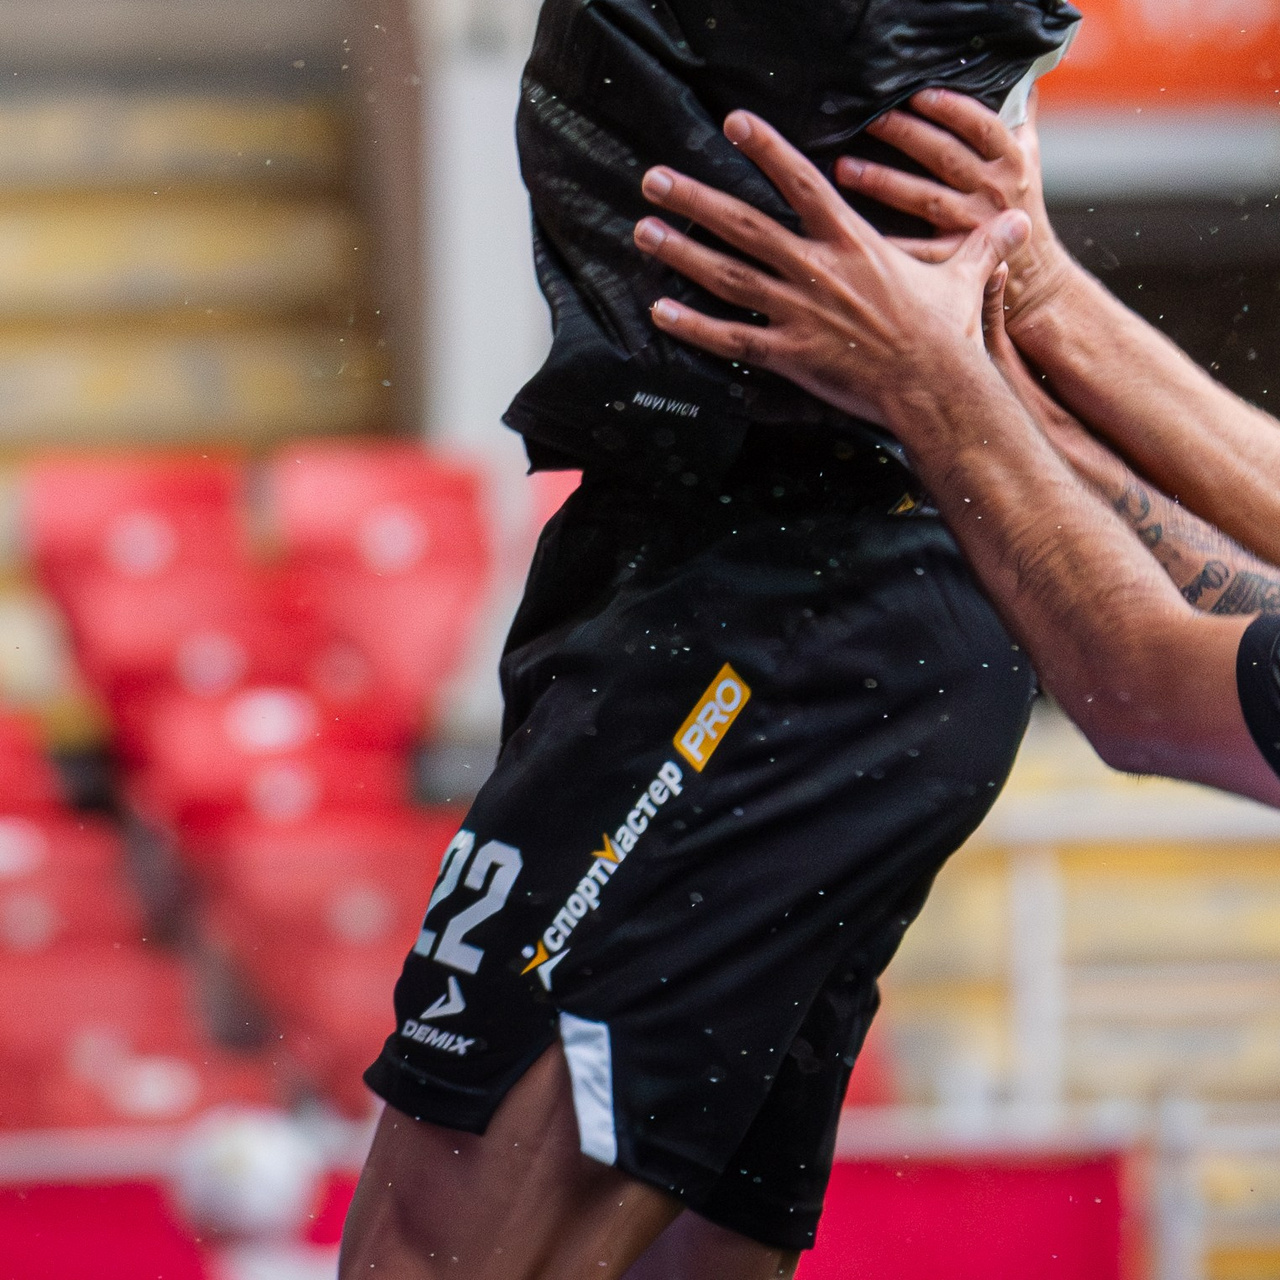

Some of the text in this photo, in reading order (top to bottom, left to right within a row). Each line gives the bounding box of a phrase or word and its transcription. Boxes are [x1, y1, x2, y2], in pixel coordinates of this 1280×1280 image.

[681, 678, 742, 762] PRO
[413, 829, 523, 975] 22
[402, 1019, 475, 1056] DEMIX
